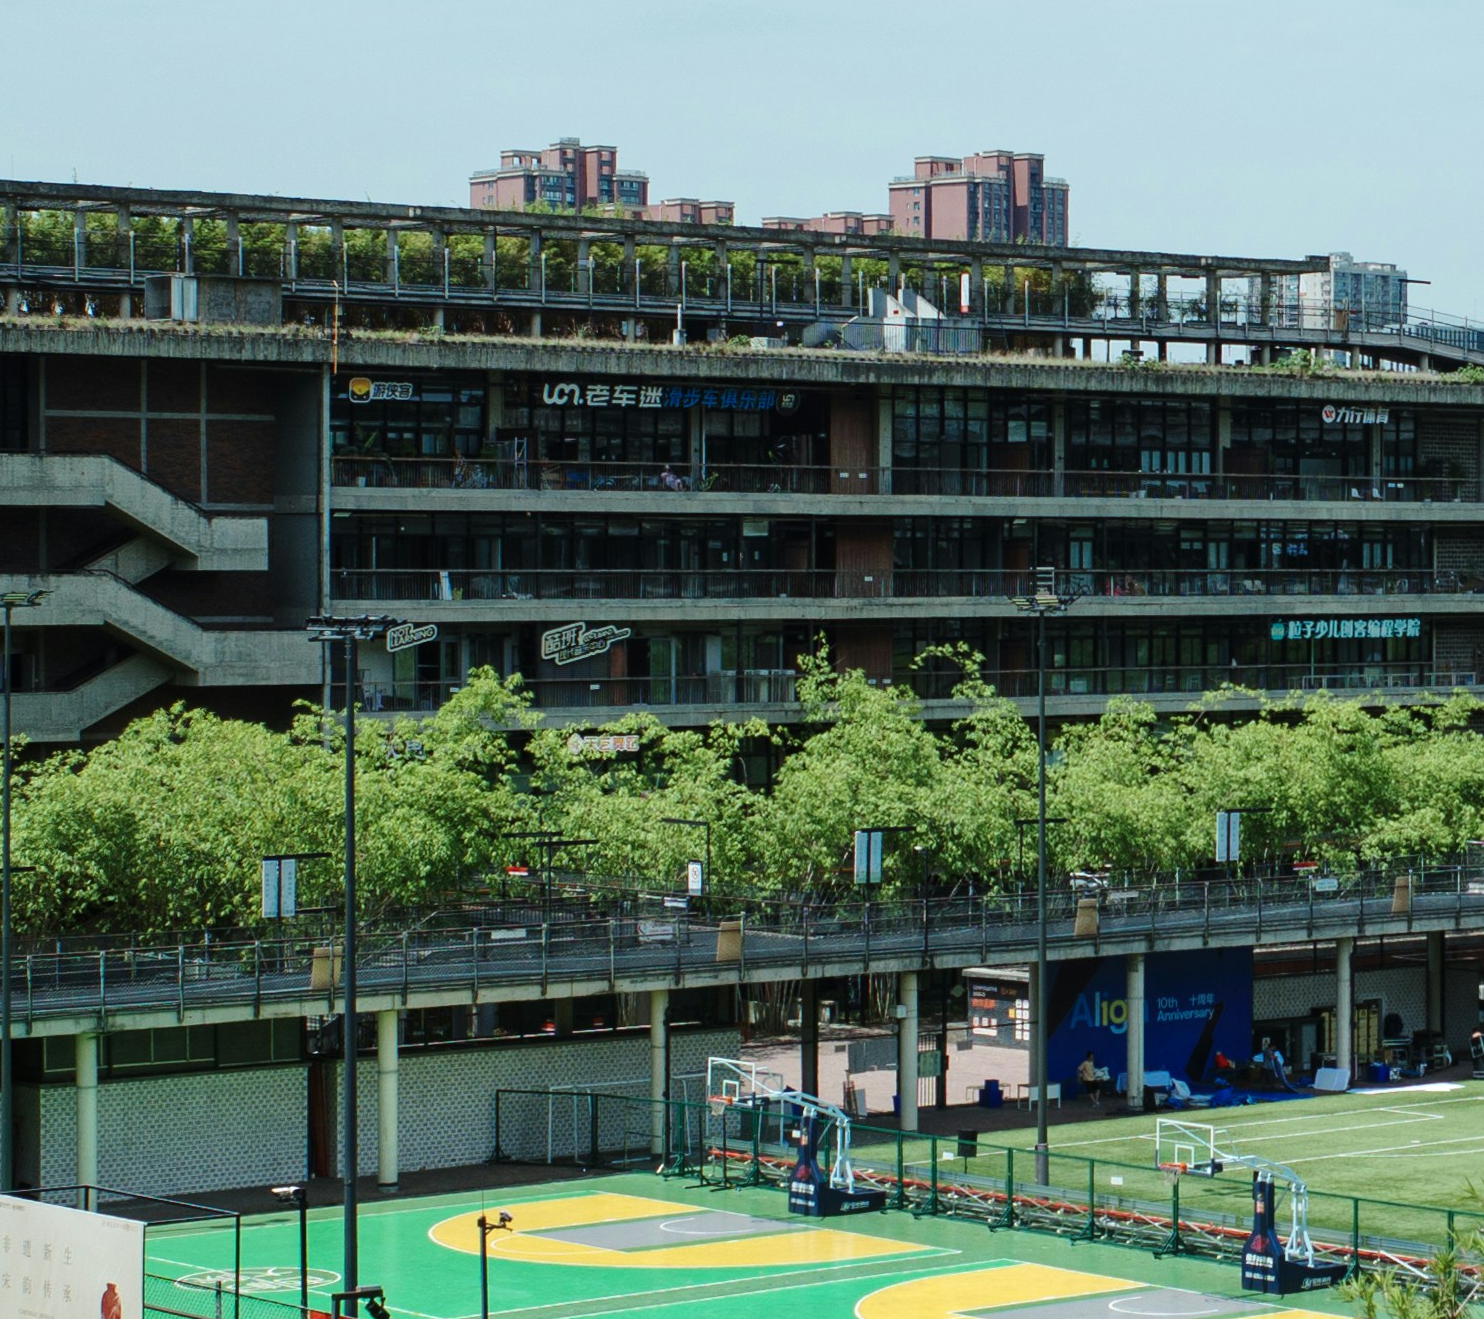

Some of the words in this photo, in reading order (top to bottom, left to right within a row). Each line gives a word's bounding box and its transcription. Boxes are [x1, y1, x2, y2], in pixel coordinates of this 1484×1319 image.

[585, 384, 662, 408] 老车迷
[663, 387, 776, 409] 滑步车俱乐部
[1336, 406, 1390, 424] 力行体育
[1287, 618, 1421, 640] 粒子少儿创客编程学院
[545, 628, 577, 654] 酷班
[1069, 991, 1149, 1035] Alig
[1156, 997, 1178, 1009] 10th
[1156, 1009, 1215, 1022] Anniversary
